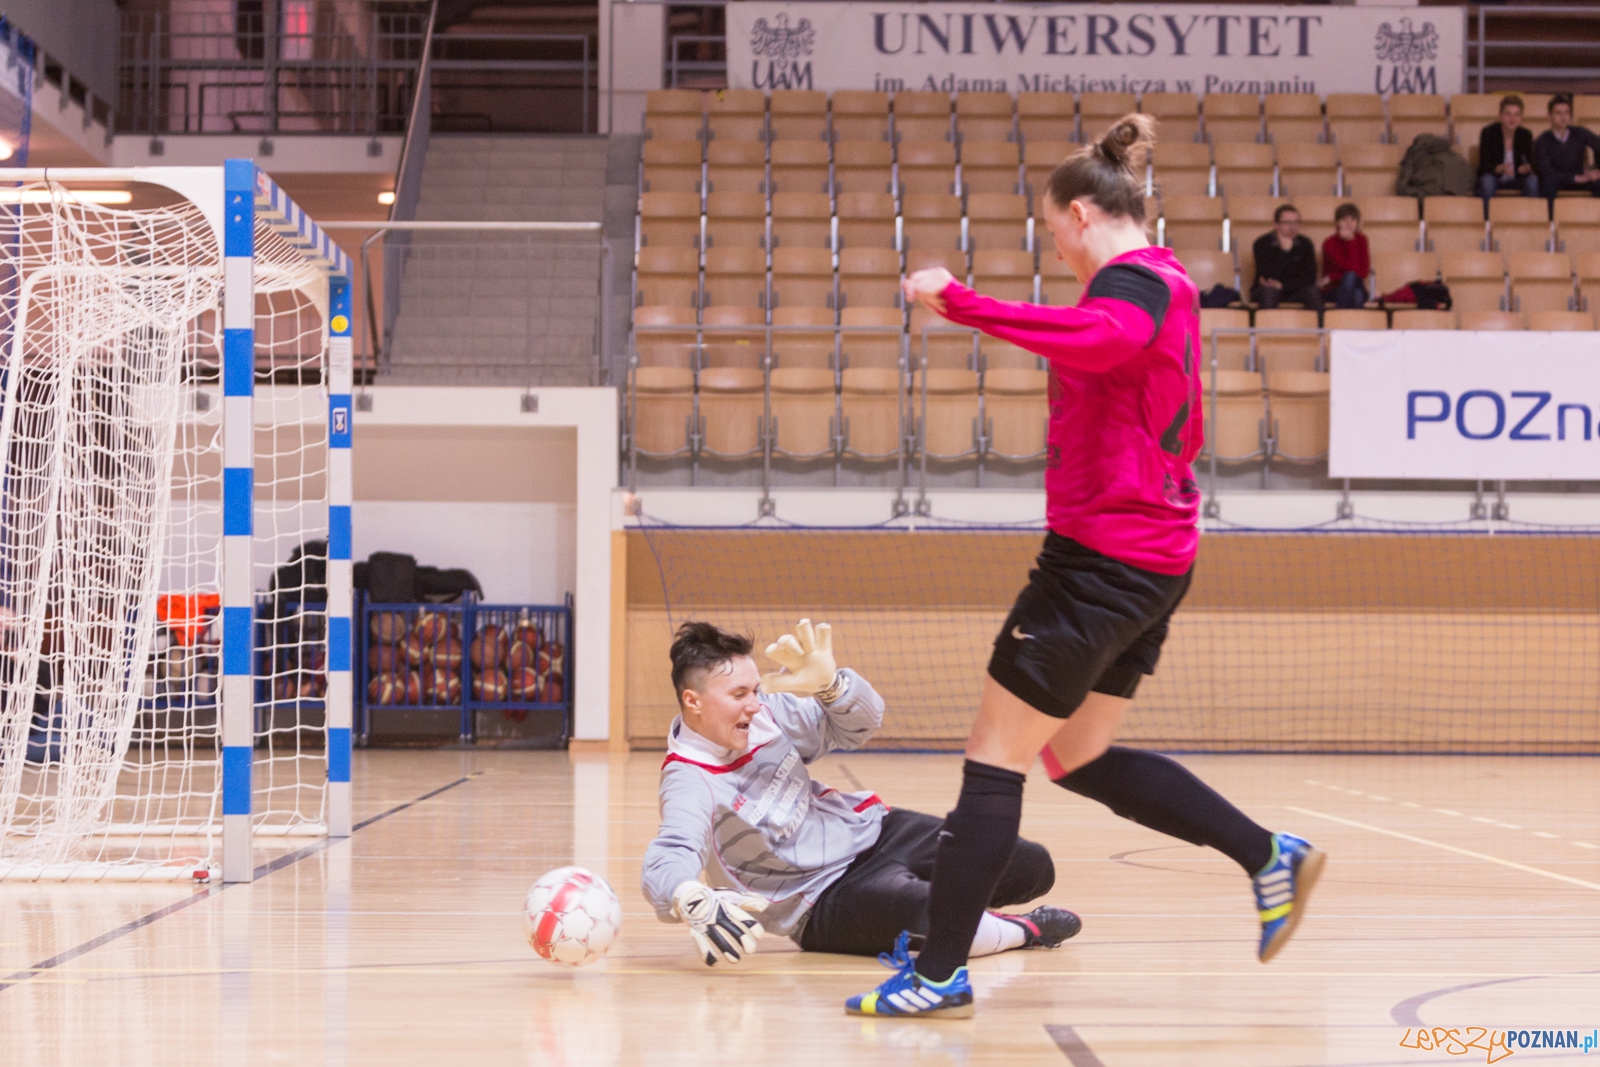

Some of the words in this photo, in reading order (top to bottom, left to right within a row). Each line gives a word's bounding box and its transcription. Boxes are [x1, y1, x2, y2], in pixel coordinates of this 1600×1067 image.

[872, 12, 1322, 57] UNIWERSYTET
[875, 72, 912, 92] im.
[922, 73, 1008, 92] Adama
[1017, 72, 1165, 93] Mickiewicza
[1175, 79, 1195, 94] w
[1203, 74, 1315, 94] Poznaniu
[1406, 389, 1600, 441] POZn
